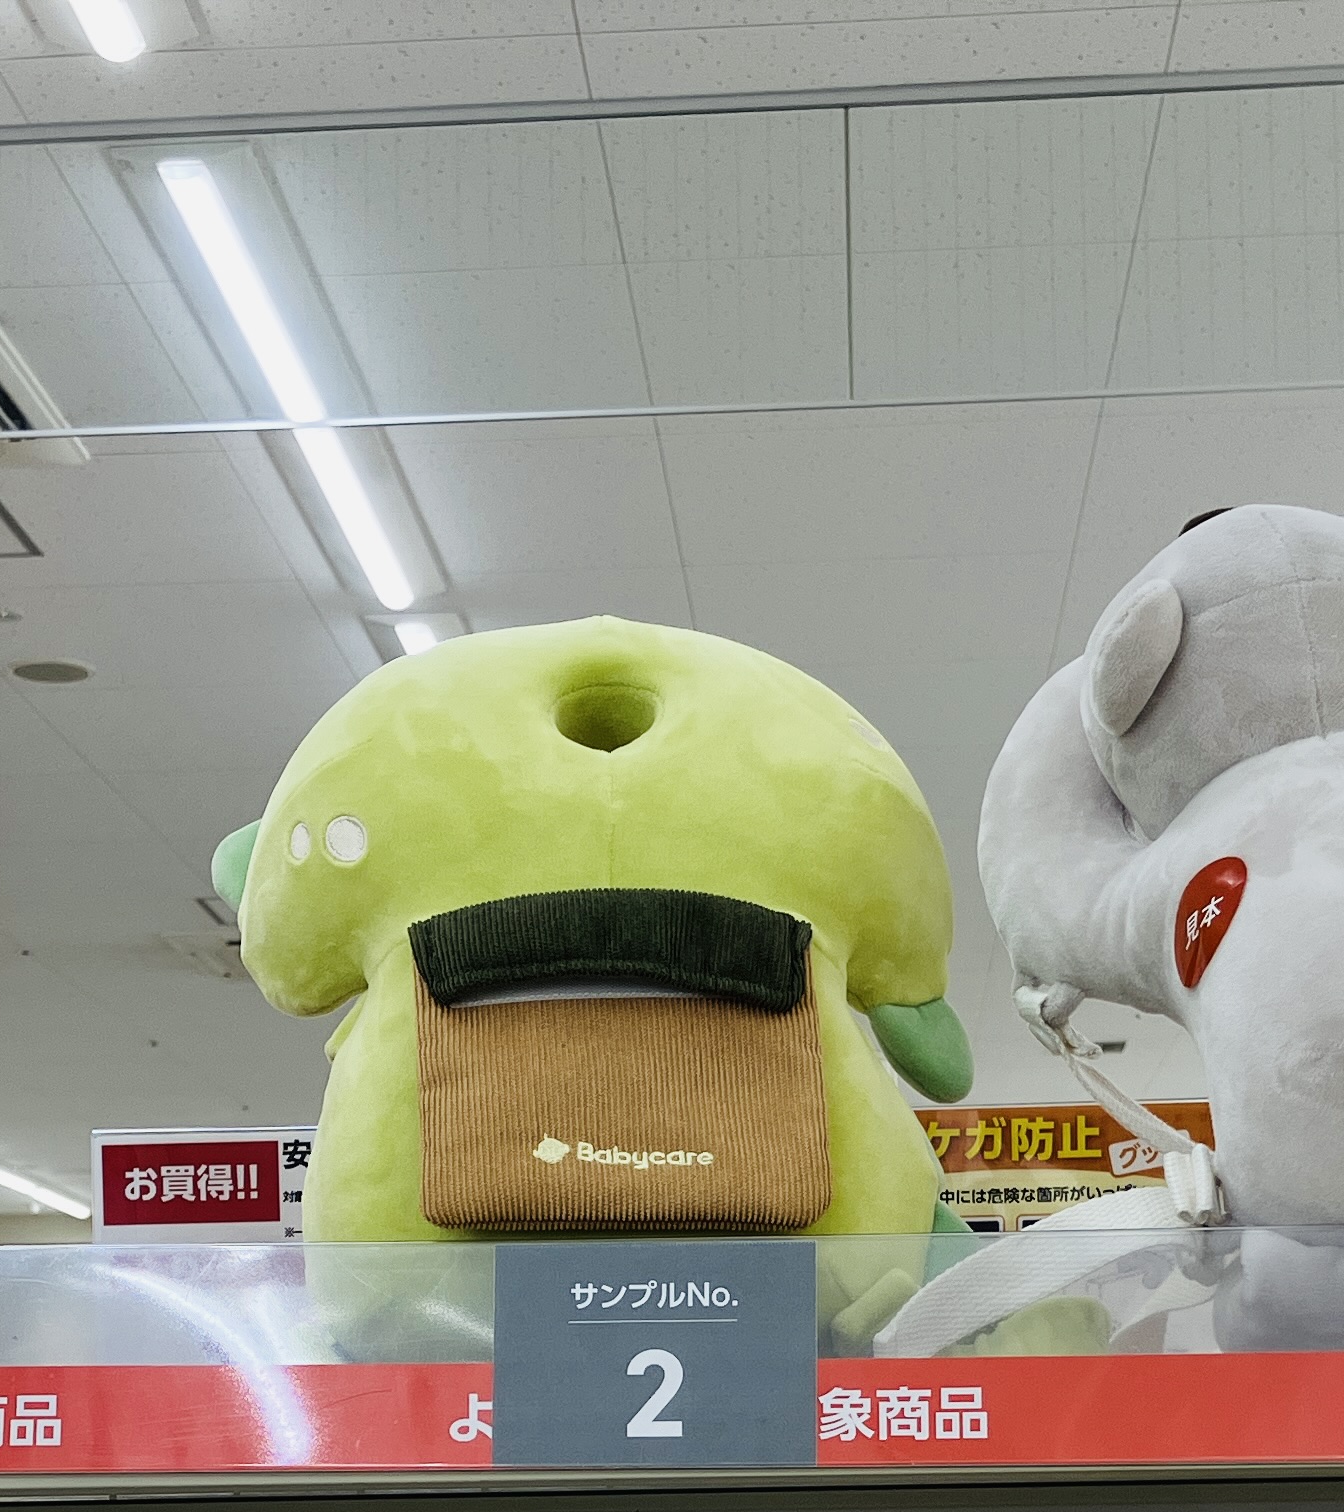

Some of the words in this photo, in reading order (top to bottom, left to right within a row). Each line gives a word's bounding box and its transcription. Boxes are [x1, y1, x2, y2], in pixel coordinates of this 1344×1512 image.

[1186, 896, 1224, 950] 見本
[577, 1142, 714, 1169] Babycare
[928, 1116, 1102, 1162] ケガ防止
[125, 1164, 259, 1203] お買得!!
[570, 1281, 740, 1311] サンプルNo.
[626, 1349, 684, 1439] 2
[818, 1384, 989, 1442] 象商品
